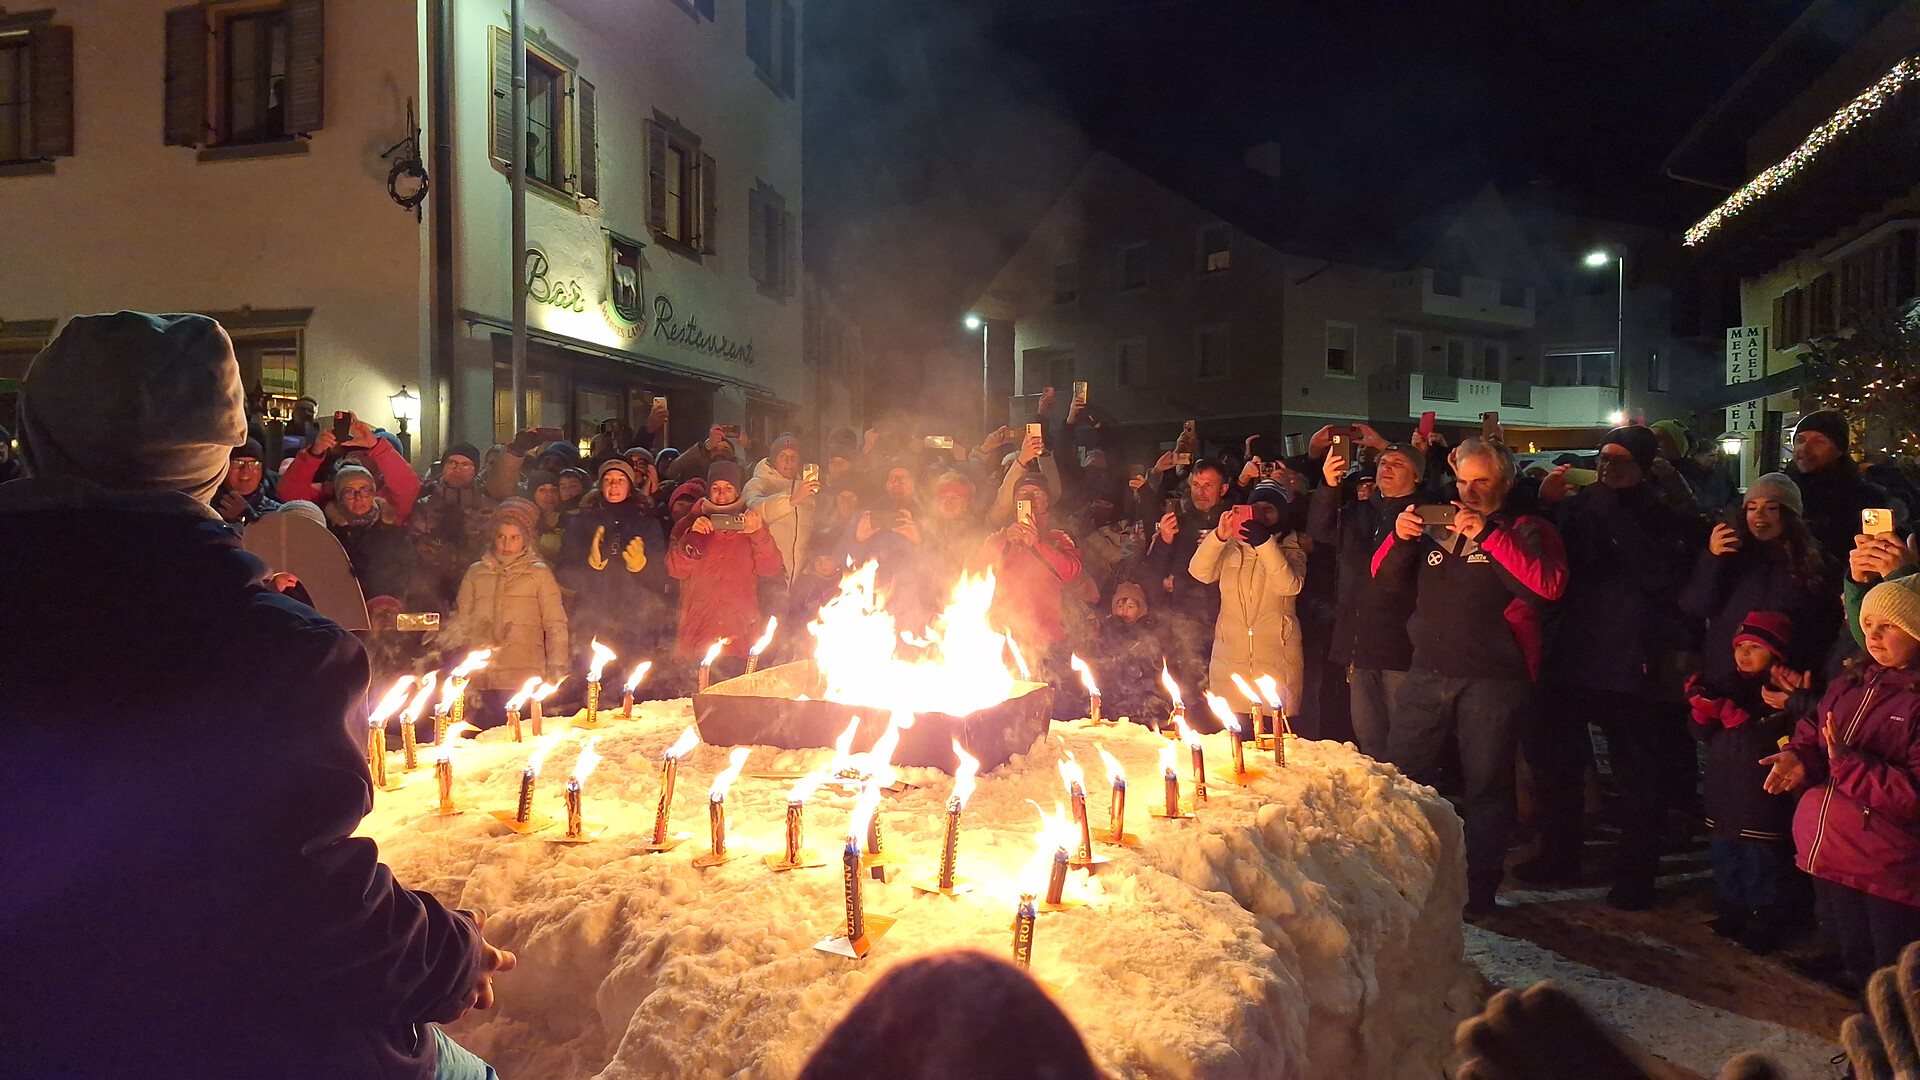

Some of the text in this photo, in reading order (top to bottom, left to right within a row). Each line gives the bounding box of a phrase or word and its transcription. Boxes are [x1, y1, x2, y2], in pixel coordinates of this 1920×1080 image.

[525, 248, 584, 313] Bar
[654, 294, 755, 365] Restaurant
[1731, 329, 1742, 431] METZGEI
[1747, 327, 1759, 430] MACELRIA
[843, 863, 856, 936] ANTIVENTO
[1019, 914, 1031, 943] ROM
